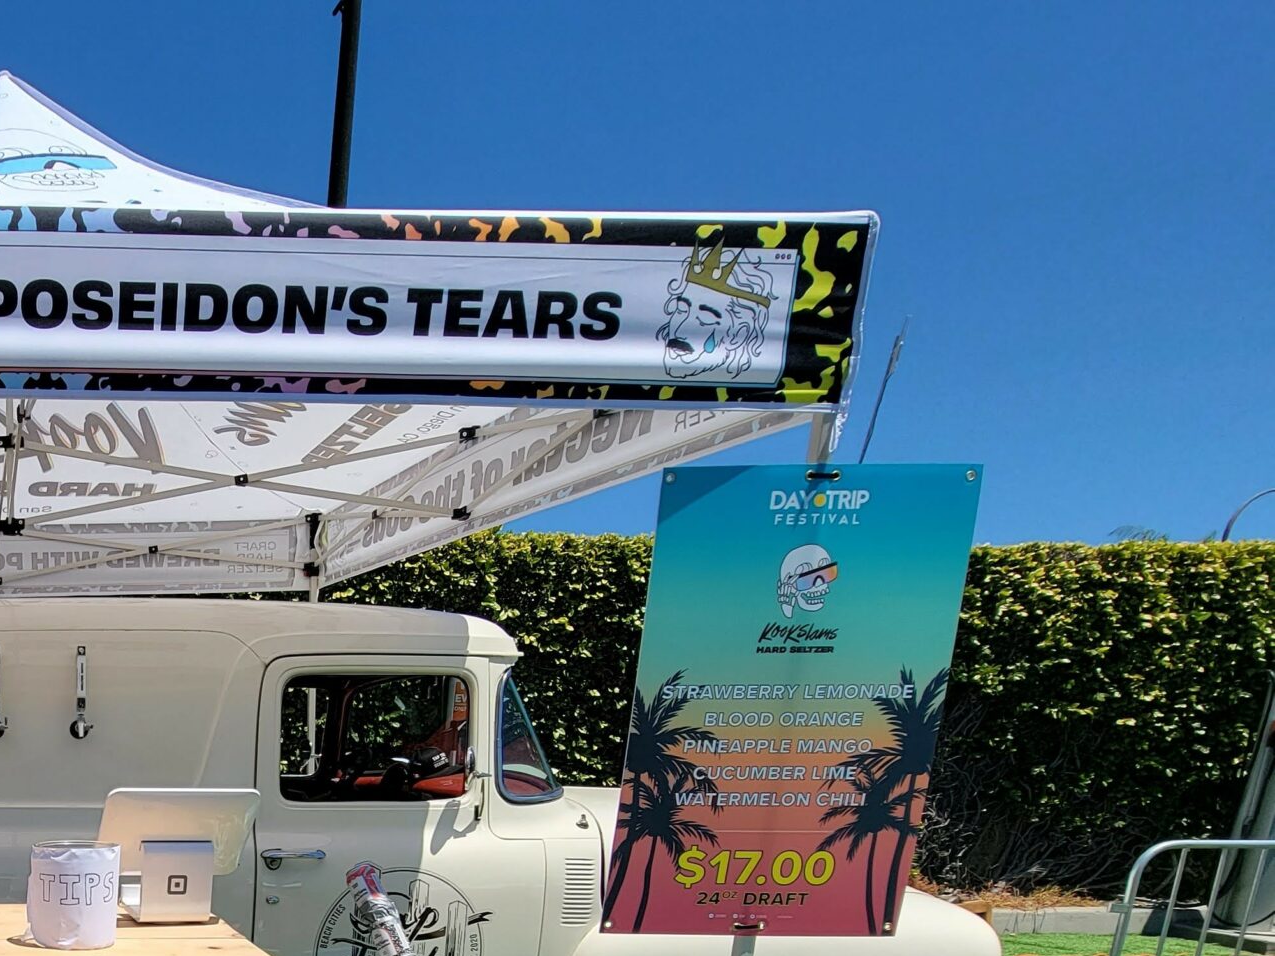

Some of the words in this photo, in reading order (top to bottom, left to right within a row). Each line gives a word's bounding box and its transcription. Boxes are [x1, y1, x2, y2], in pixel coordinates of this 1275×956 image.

[406, 288, 623, 341] TEARS
[769, 489, 816, 510] DAY
[823, 490, 870, 510] TRIP
[773, 513, 861, 525] FESTIVAL
[662, 684, 798, 700] STRAWBERRY
[803, 684, 914, 699] LEMONADE
[703, 712, 775, 728] BLOOD
[779, 712, 863, 727] ORANGE
[682, 739, 792, 754] PINEAPPLE
[797, 739, 873, 754] MANGO
[693, 766, 806, 781] CUCUMBER
[811, 766, 856, 781] LIME
[674, 792, 812, 807] WATERMELON
[818, 792, 866, 807] CHILI
[674, 845, 835, 888] $17.00
[39, 872, 116, 906] TIPS
[742, 891, 809, 906] DRAFT
[319, 924, 334, 949] BEACH
[331, 904, 347, 926] CITIES
[470, 933, 479, 953] 2020
